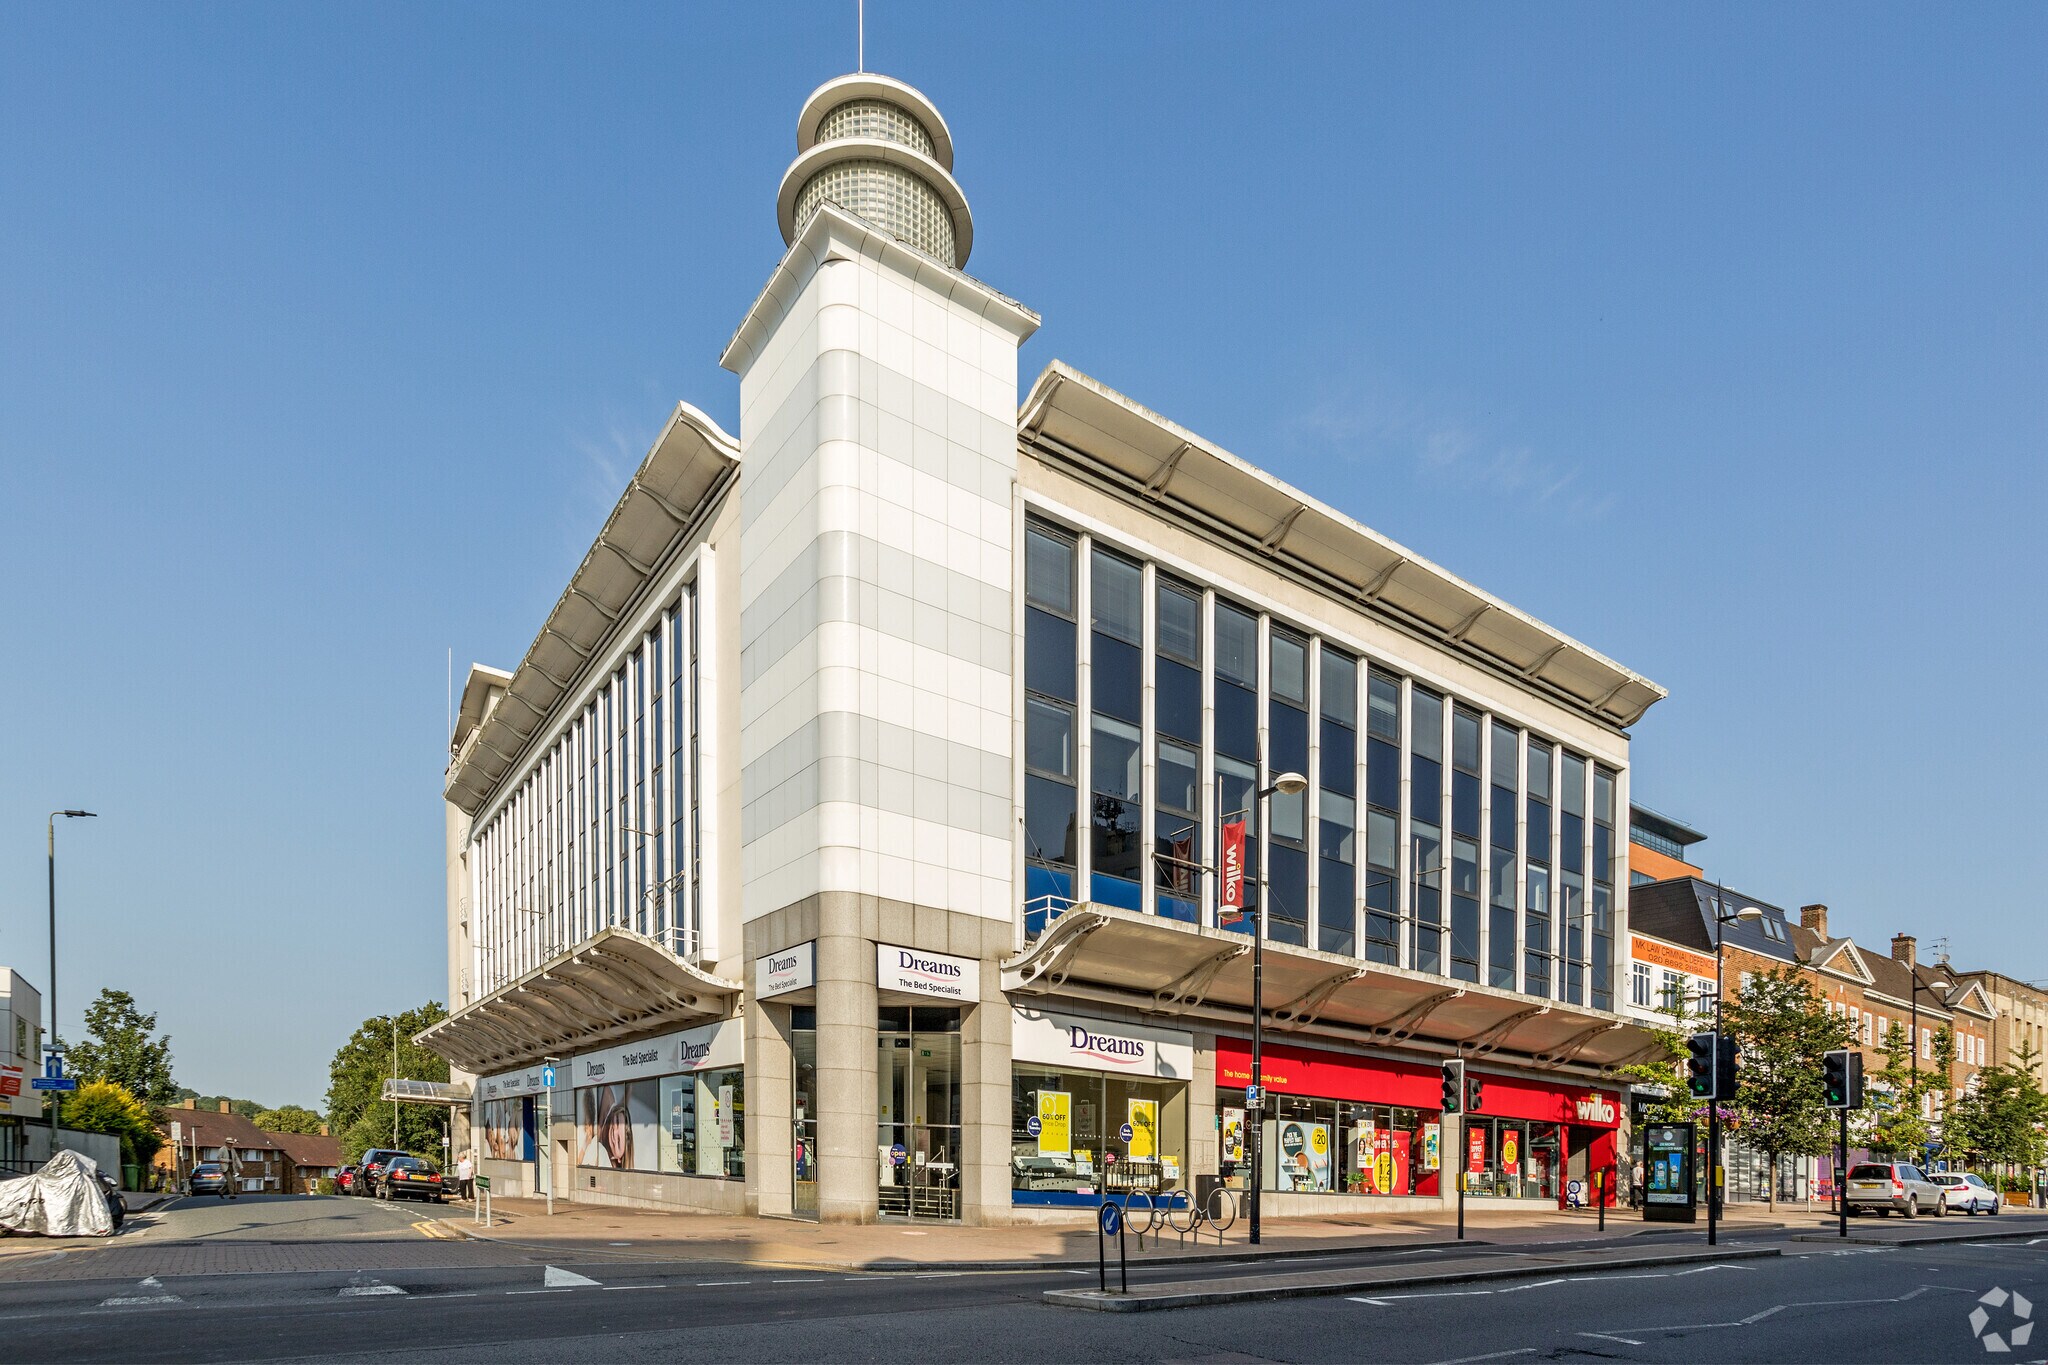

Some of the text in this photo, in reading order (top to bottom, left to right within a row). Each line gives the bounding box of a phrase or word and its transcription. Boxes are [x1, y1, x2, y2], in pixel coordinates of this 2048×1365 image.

[1226, 844, 1241, 902] wilko
[899, 951, 961, 977] Dreams
[1636, 940, 1715, 970] MK LAW CRIMINAL DEFENCE
[1648, 954, 1663, 964] 020
[769, 955, 797, 975] Dreams
[781, 978, 798, 989] Specialist
[899, 978, 962, 996] The Bed Specialist
[1070, 1025, 1144, 1057] Dreams
[622, 1049, 659, 1067] The Bed Specialist
[681, 1041, 710, 1060] Dreams
[587, 1061, 605, 1077] Dreams
[1224, 1069, 1234, 1077] The
[1234, 1071, 1250, 1080] home
[1273, 1076, 1288, 1084] value
[527, 1074, 540, 1087] Dreams
[1249, 1087, 1255, 1098] P
[1576, 1093, 1615, 1123] wilko
[1315, 1134, 1326, 1145] £20
